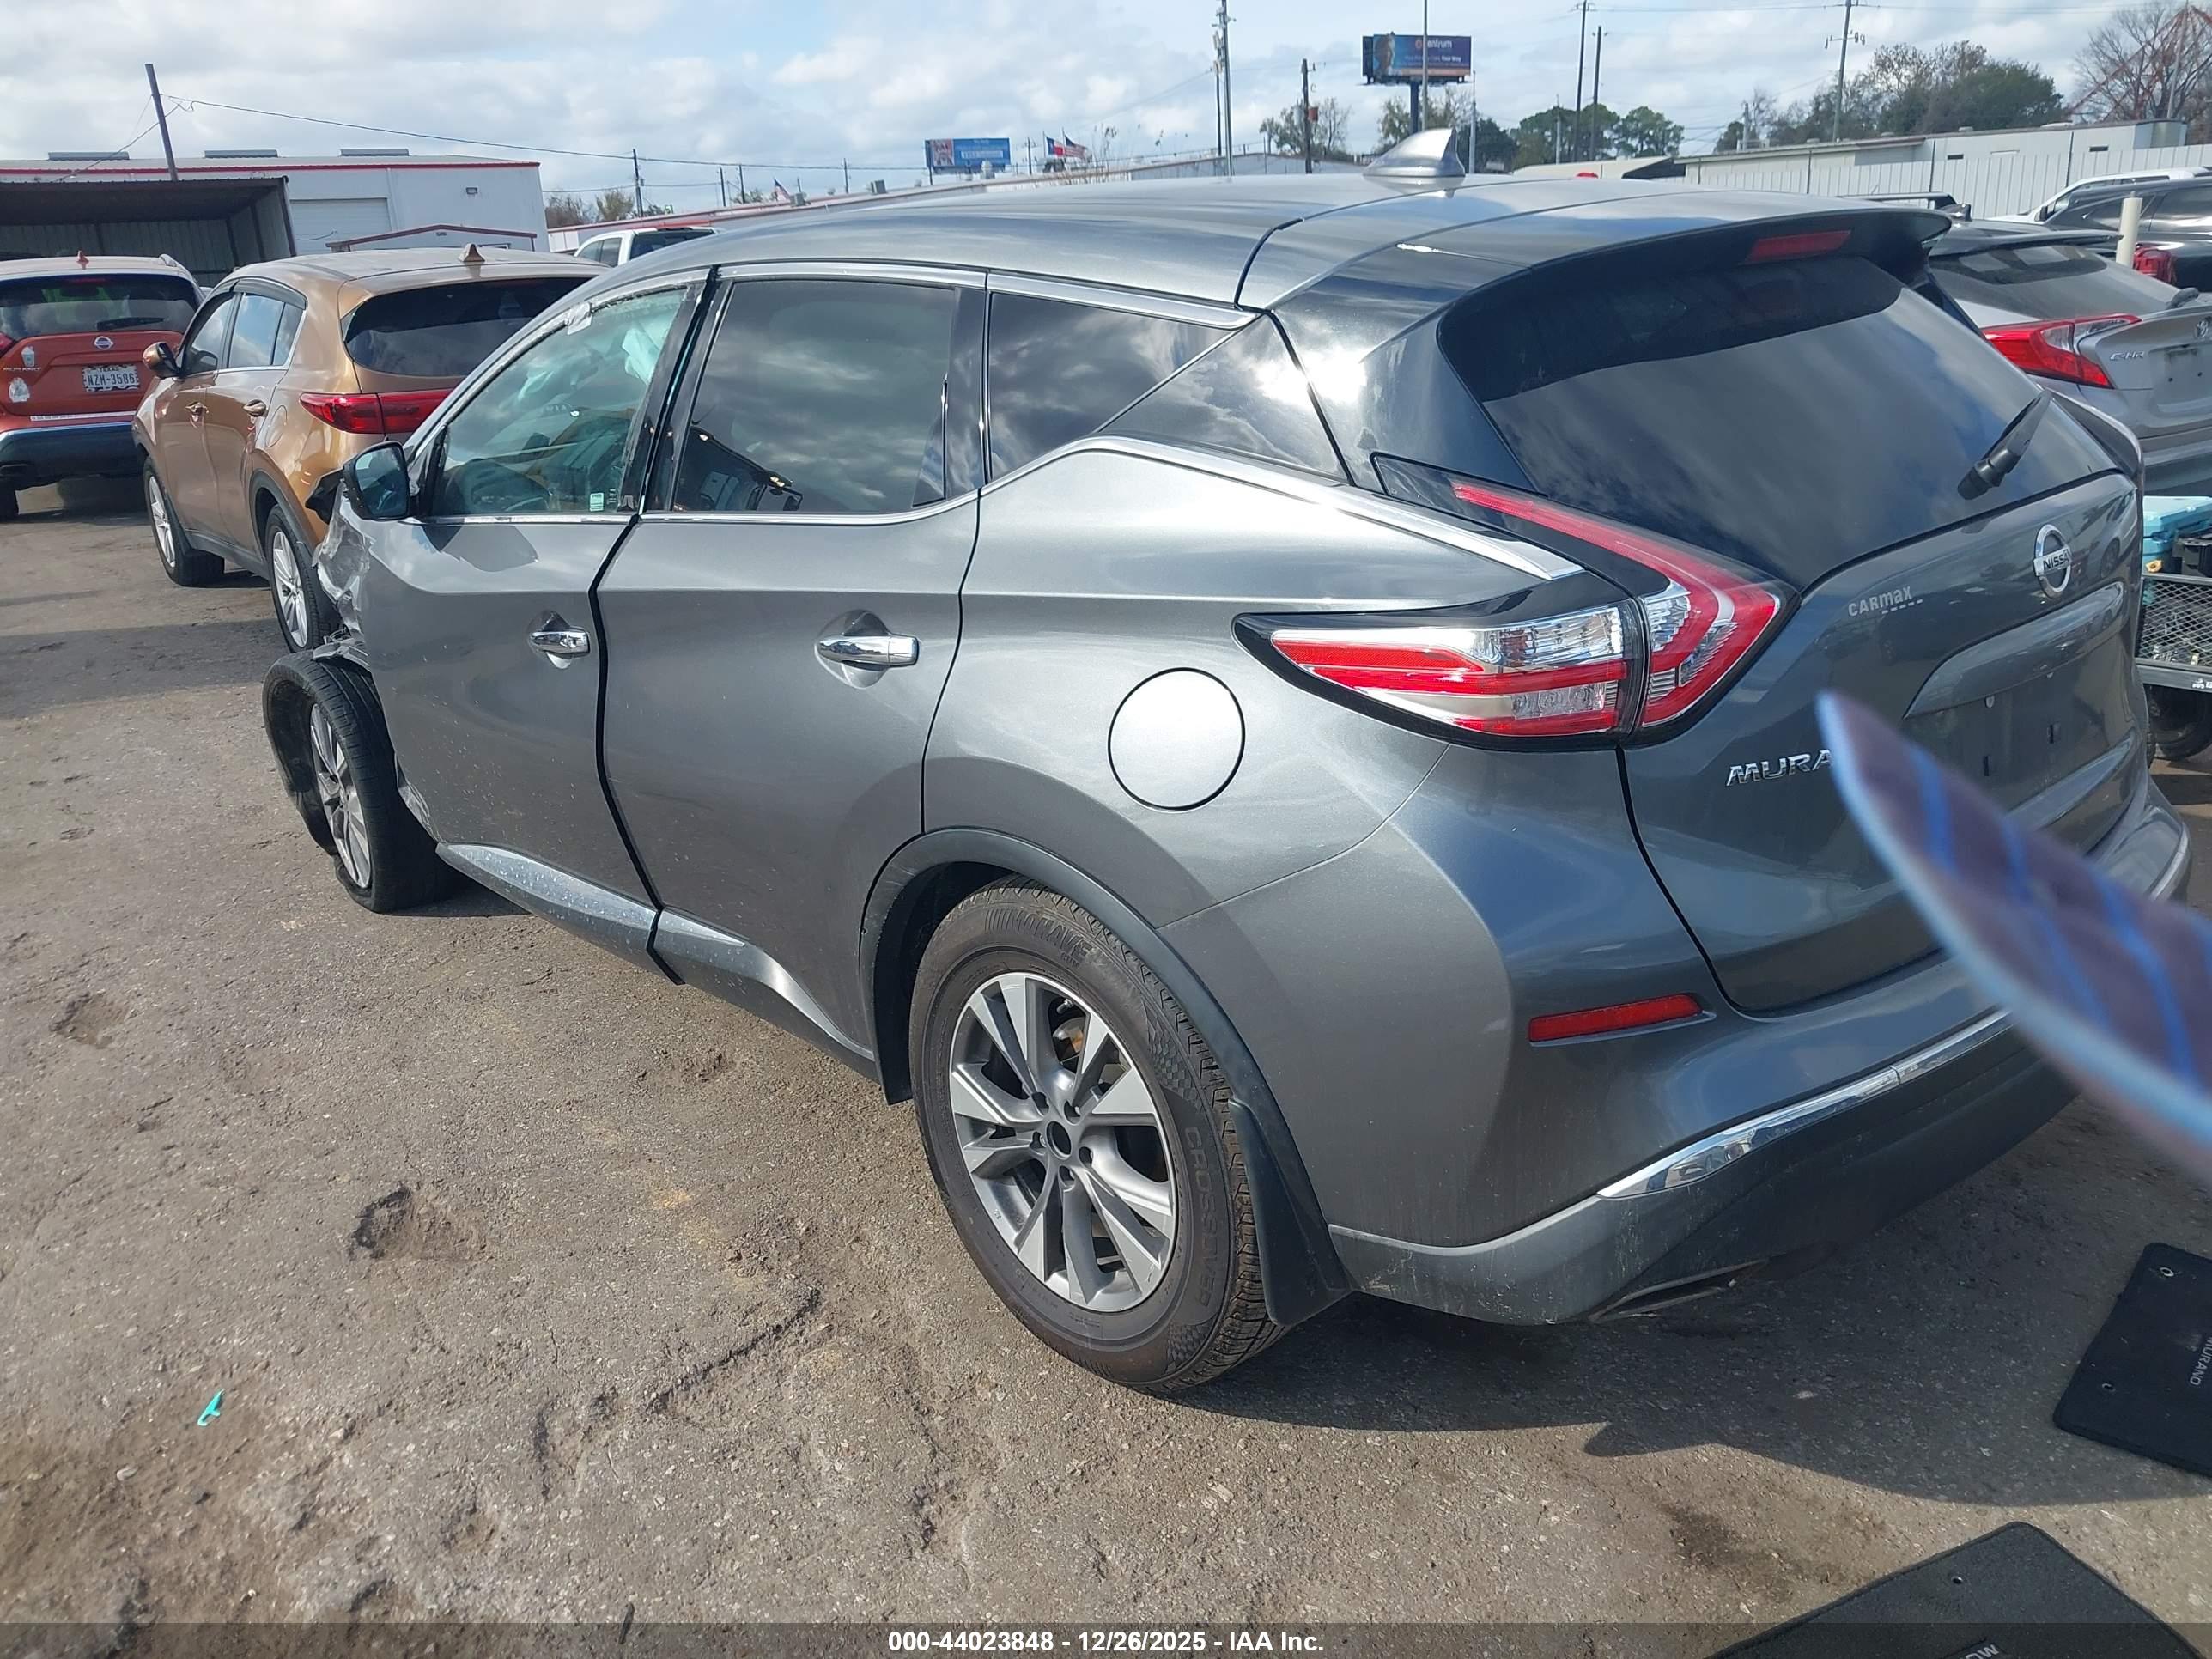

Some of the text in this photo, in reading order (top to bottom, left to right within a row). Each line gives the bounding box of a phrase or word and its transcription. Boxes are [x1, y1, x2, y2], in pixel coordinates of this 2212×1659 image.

[87, 373, 136, 386] NZM-3586
[2043, 549, 2070, 570] NISSA
[1726, 749, 1832, 787] MURA
[1184, 1126, 1219, 1308] CROSSOVER
